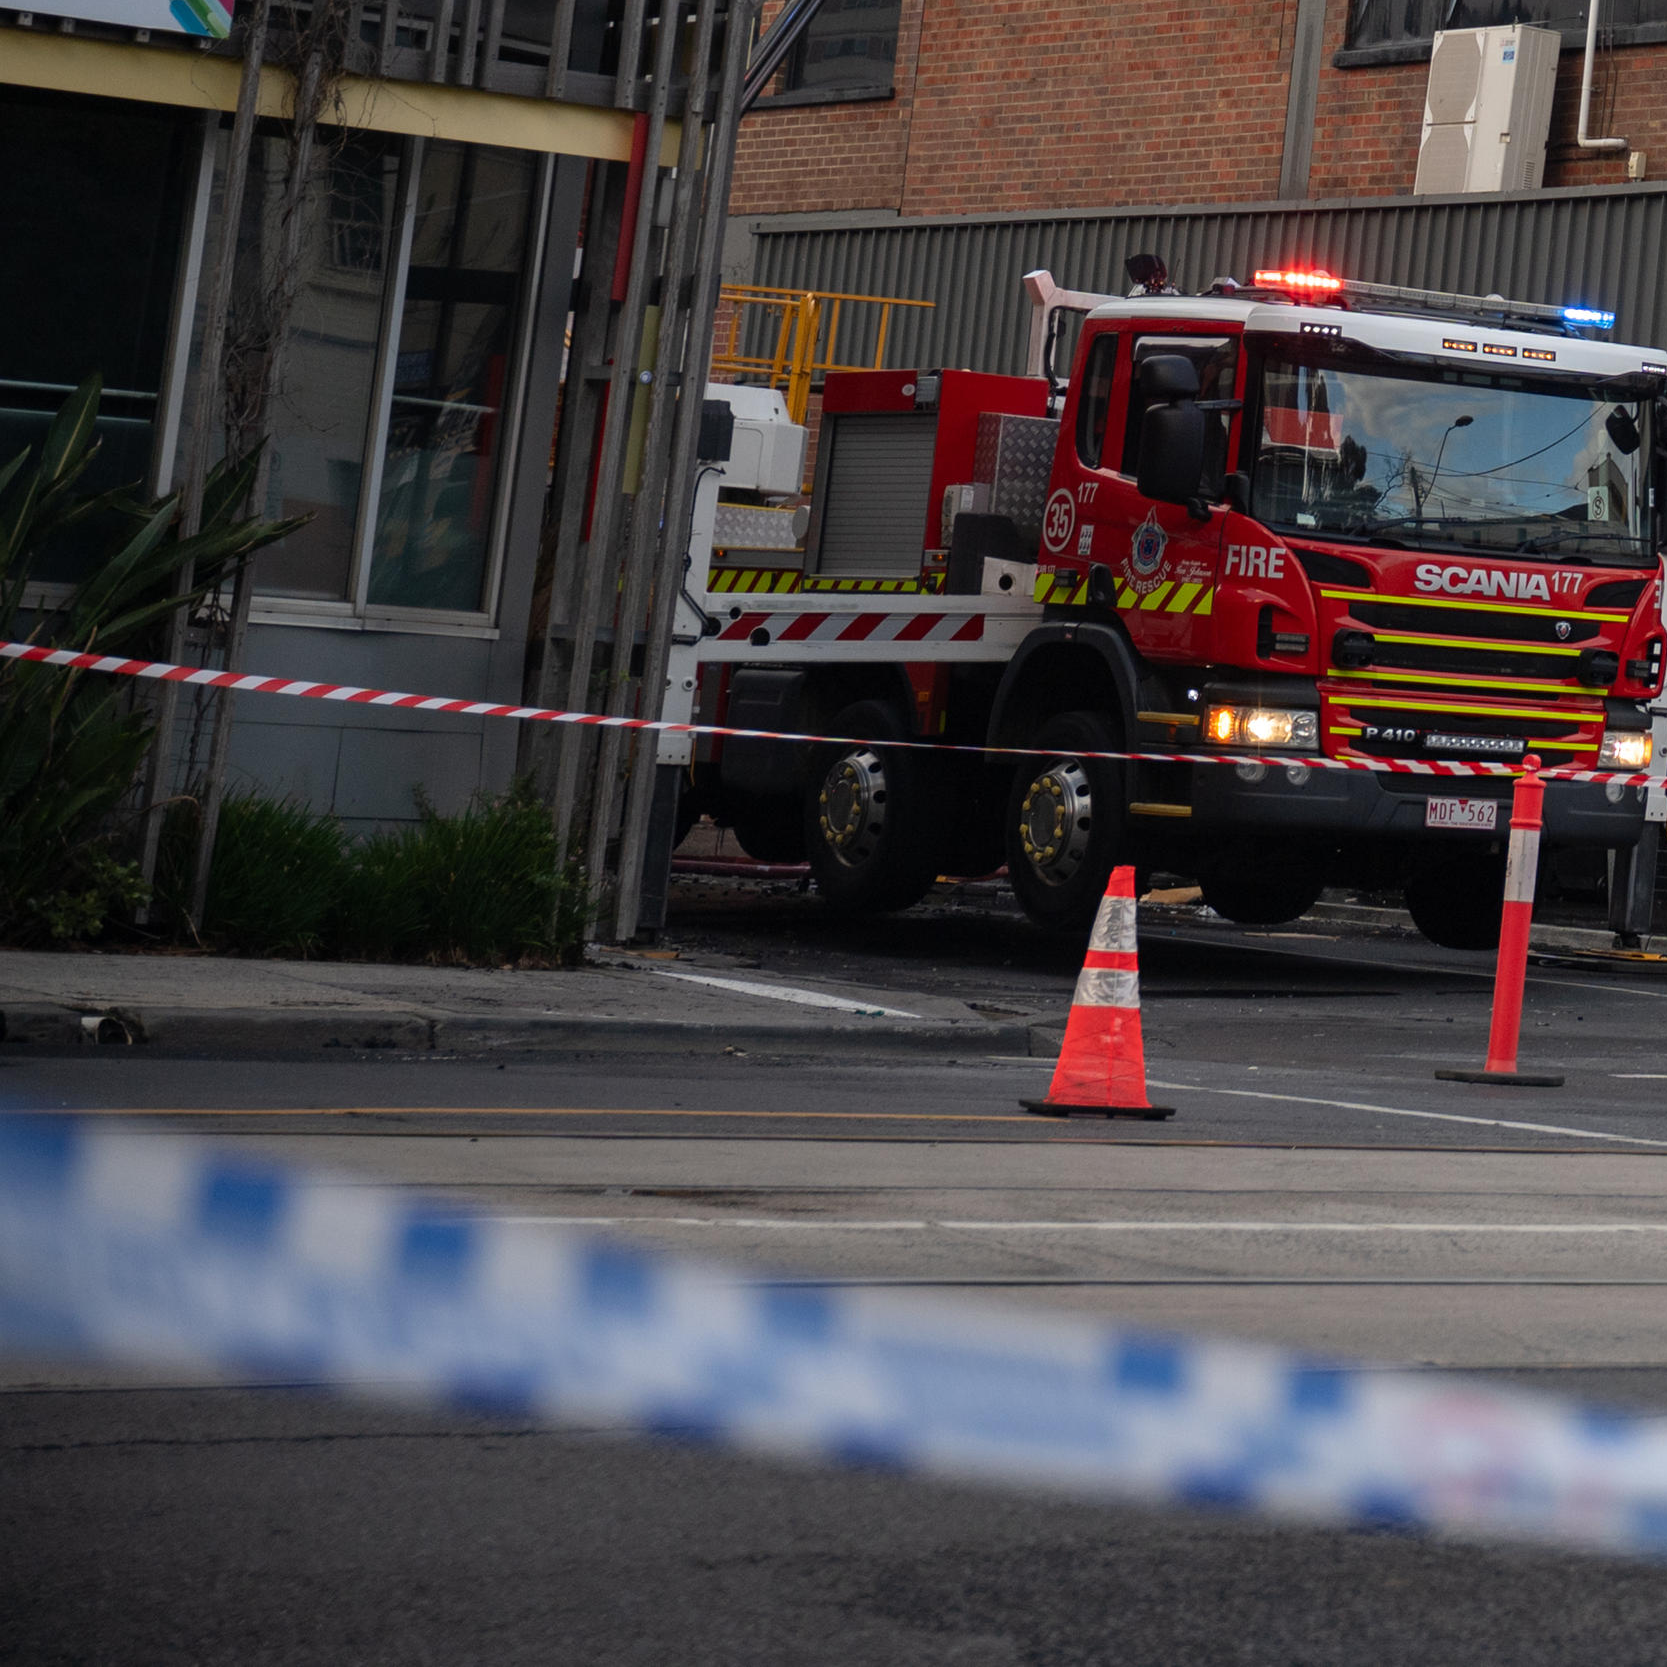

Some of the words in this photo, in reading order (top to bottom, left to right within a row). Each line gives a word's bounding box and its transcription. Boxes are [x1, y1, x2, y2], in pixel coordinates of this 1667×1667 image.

[1078, 482, 1099, 504] 177
[1048, 503, 1071, 538] 35
[1120, 557, 1136, 588] FIRE
[1135, 560, 1172, 594] RESCUE
[1225, 544, 1287, 579] FIRE
[1414, 564, 1551, 601] SCANIA
[1551, 571, 1584, 594] 177
[1365, 727, 1379, 739] P
[1381, 728, 1416, 742] 410
[1429, 802, 1457, 822] MDF
[1468, 804, 1495, 823] 562
